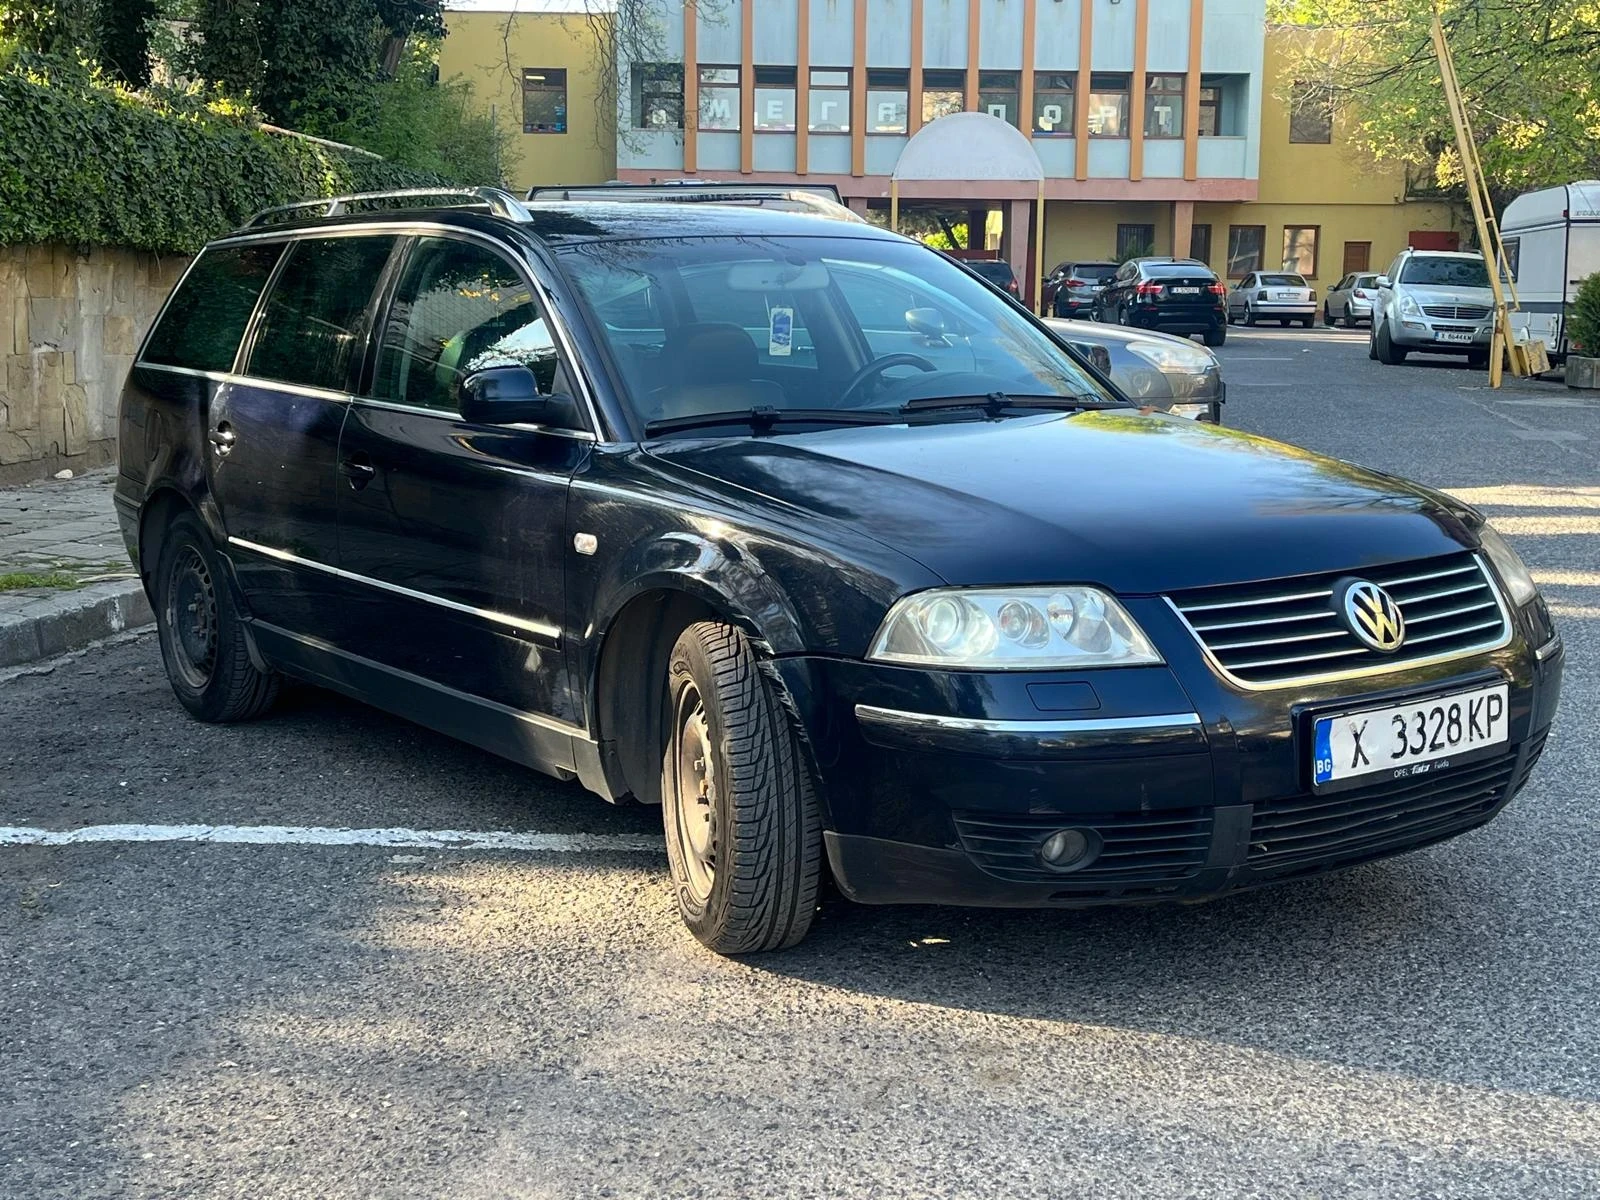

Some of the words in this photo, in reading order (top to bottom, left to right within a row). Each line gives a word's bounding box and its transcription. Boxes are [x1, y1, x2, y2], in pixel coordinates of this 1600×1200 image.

[709, 99, 898, 122] МЕГА
[987, 103, 1172, 125] ПОРТ
[1349, 719, 1370, 768] X
[1317, 758, 1332, 775] BG
[1393, 768, 1409, 778] OPEL
